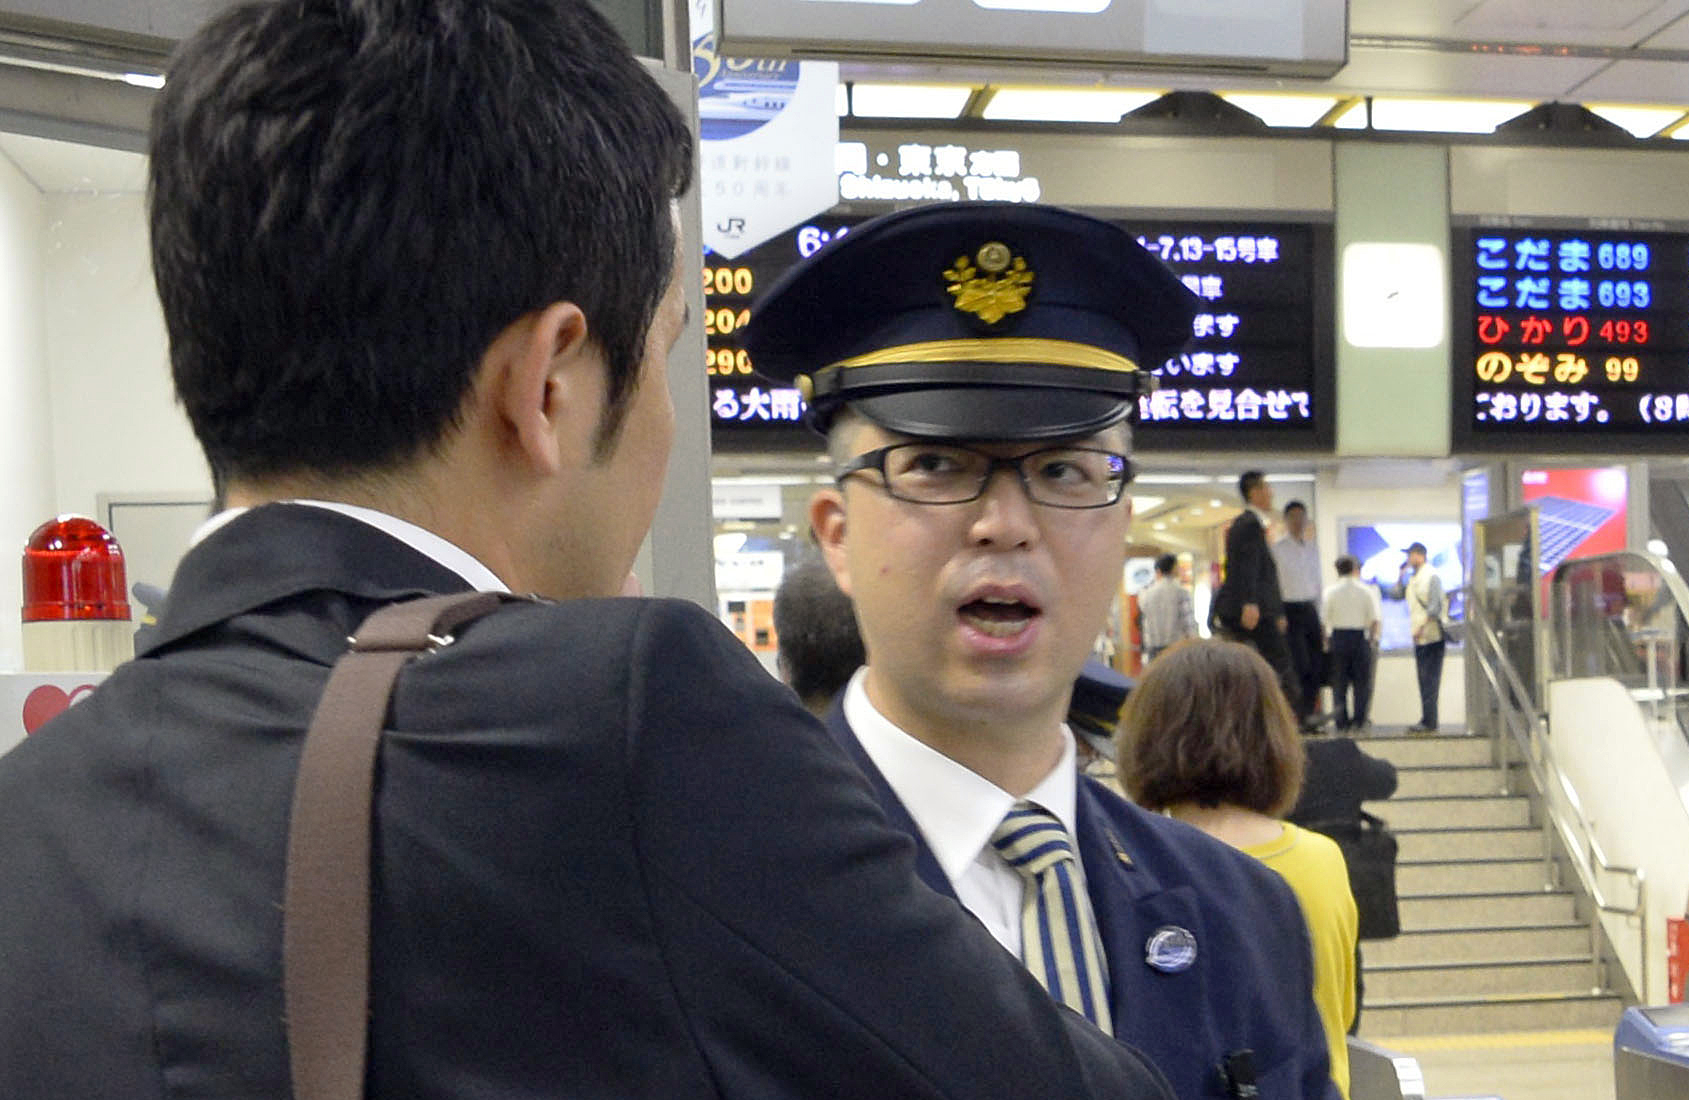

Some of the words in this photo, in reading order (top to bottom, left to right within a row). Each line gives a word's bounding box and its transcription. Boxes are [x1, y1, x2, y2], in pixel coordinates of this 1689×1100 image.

[717, 218, 746, 233] JR
[1476, 237, 1591, 272] こだま
[1598, 242, 1650, 271] 689
[1476, 275, 1591, 310] こだま
[1598, 280, 1650, 309] 693
[1477, 315, 1591, 346] ひかり
[1600, 319, 1649, 344] 493
[1476, 351, 1589, 384] のぞみ
[1605, 357, 1639, 382] 99
